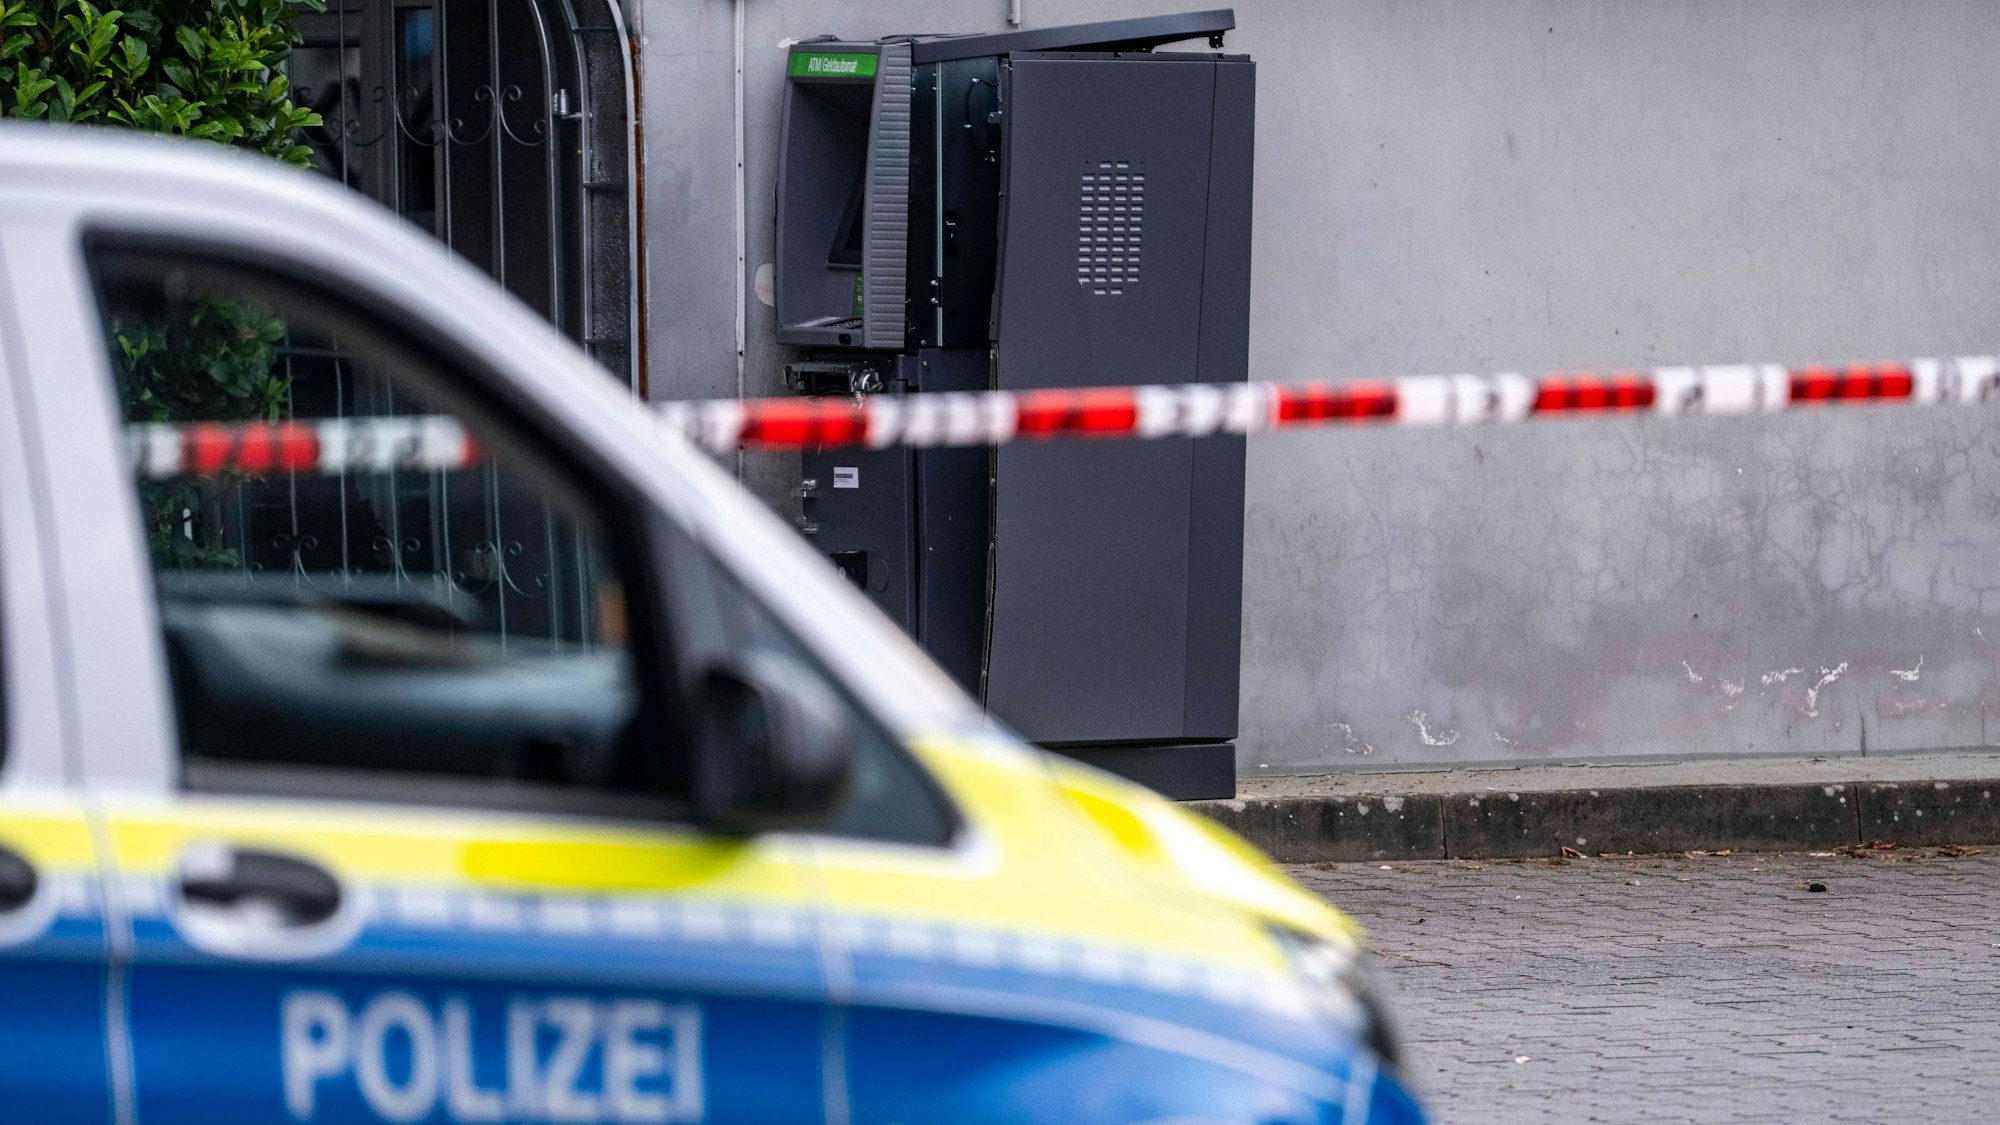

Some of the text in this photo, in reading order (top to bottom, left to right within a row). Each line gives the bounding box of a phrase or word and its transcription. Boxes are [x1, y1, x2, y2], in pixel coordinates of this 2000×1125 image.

[808, 57, 858, 73] ATM Geldautomat
[282, 989, 704, 1123] POLIZEI
